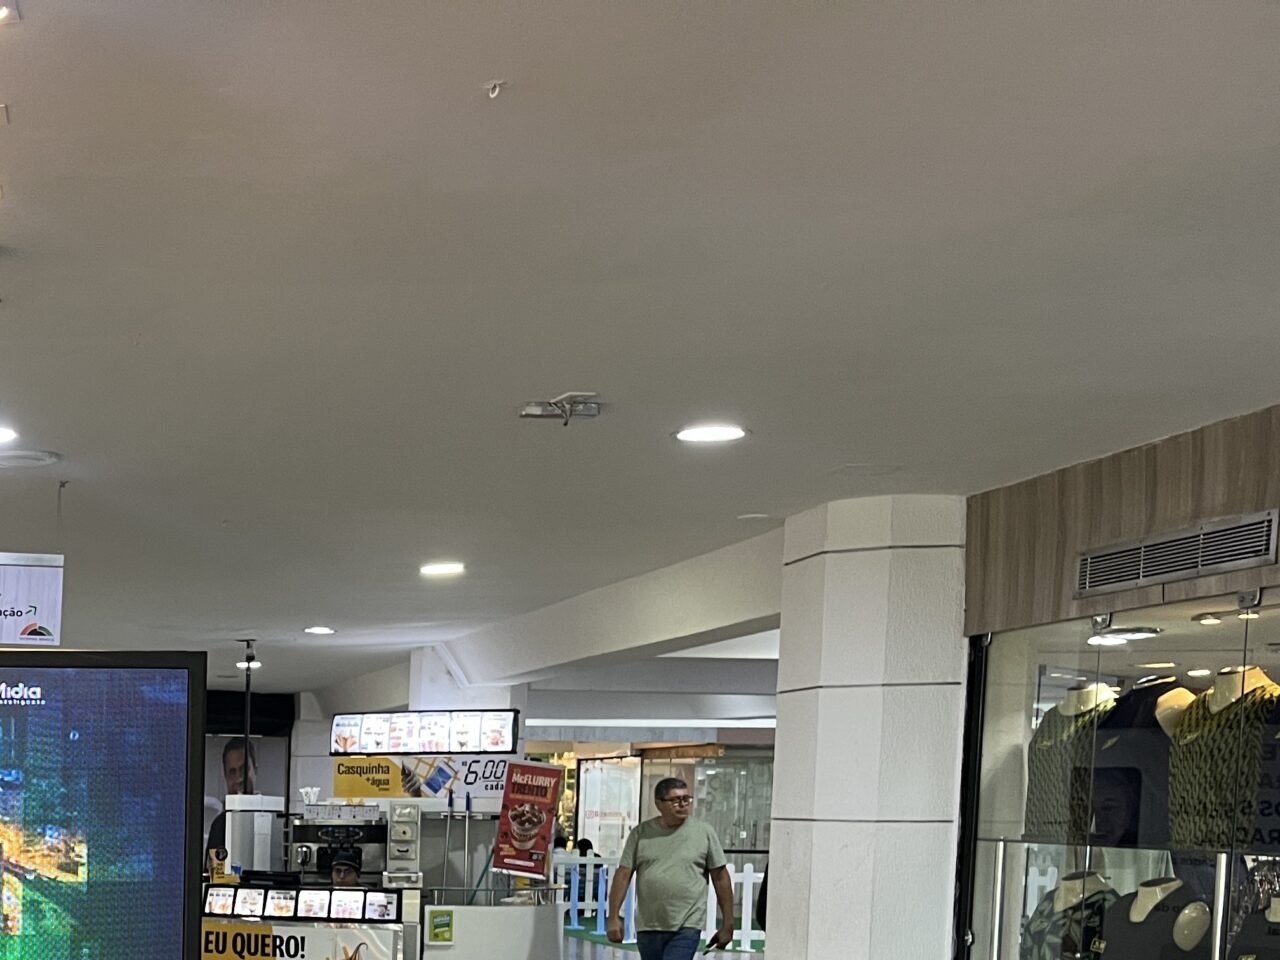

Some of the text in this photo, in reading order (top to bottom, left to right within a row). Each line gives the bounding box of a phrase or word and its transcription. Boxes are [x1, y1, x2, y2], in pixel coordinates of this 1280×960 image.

[337, 763, 390, 777] Casquinha
[484, 782, 504, 790] cada
[511, 773, 558, 787] McFLURRY
[204, 930, 306, 960] EU QUERO!
